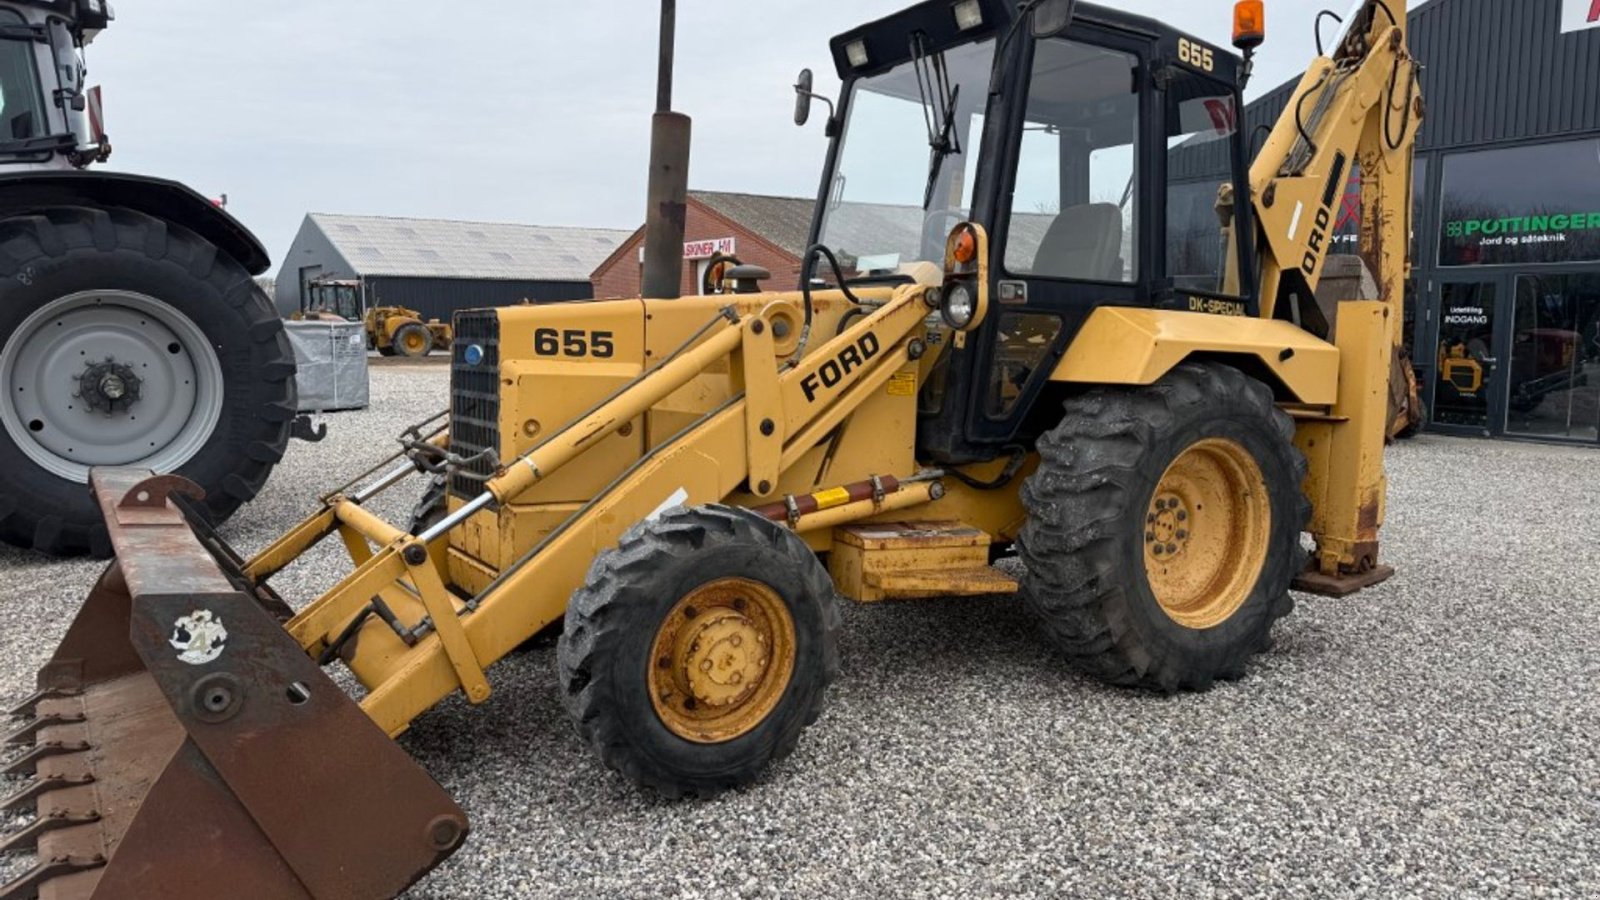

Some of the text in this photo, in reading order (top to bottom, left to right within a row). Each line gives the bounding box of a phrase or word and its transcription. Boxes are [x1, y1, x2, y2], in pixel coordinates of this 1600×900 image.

[1178, 37, 1213, 71] 655
[1302, 207, 1329, 275] ORD
[1479, 236, 1502, 245] Jord
[1505, 237, 1518, 246] og
[1445, 315, 1487, 324] INDGANG
[534, 328, 614, 358] 655
[800, 331, 880, 403] FORD
